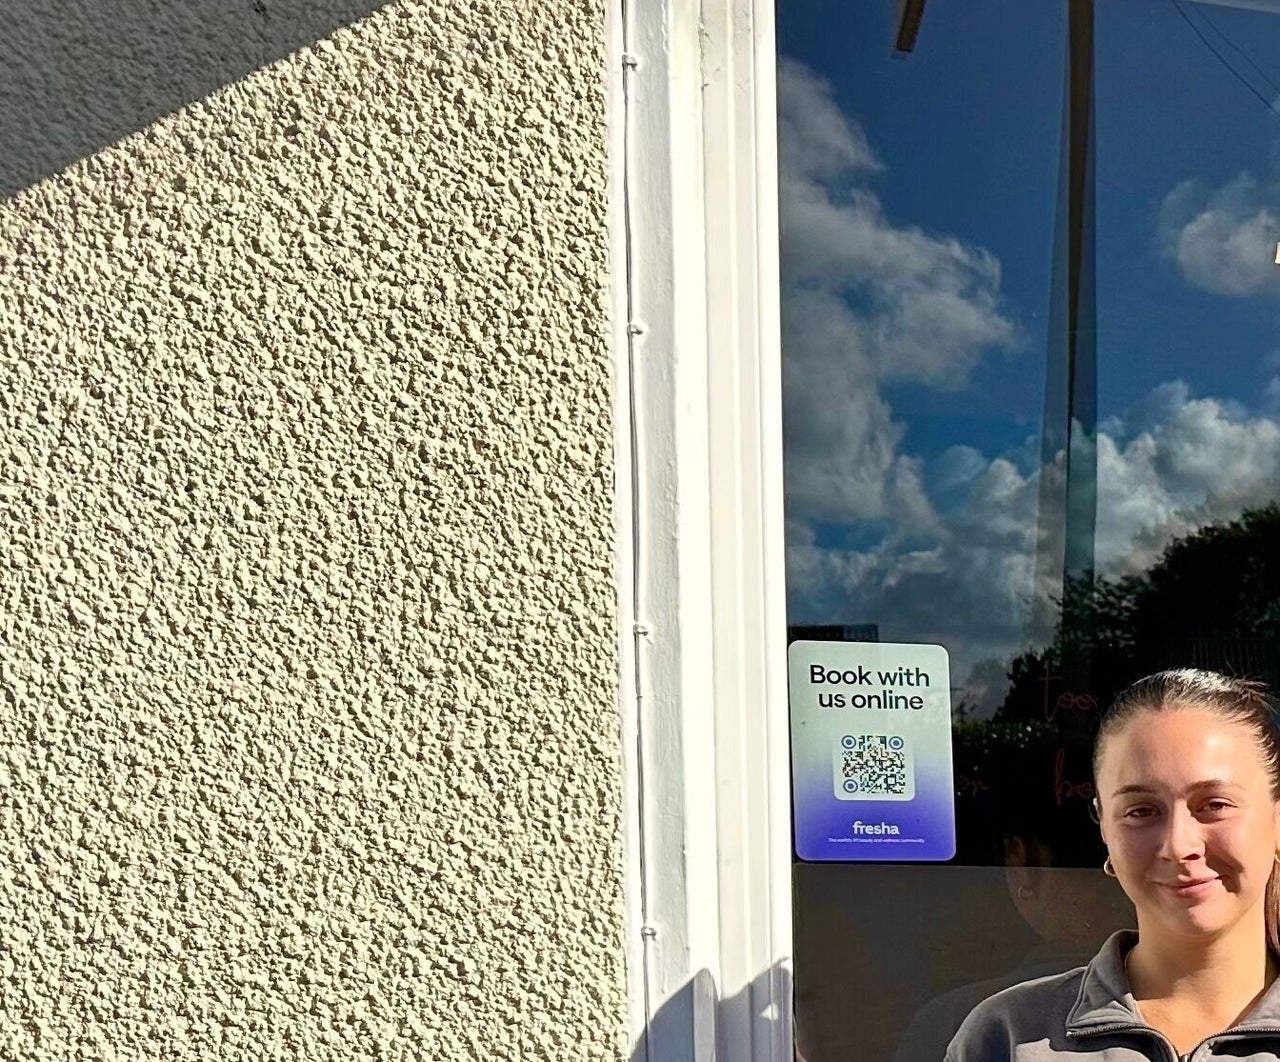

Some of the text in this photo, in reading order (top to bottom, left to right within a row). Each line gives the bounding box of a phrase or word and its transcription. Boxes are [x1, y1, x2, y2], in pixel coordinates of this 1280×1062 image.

[810, 665, 930, 687] Book with
[818, 690, 924, 709] us online
[852, 820, 900, 835] fresha
